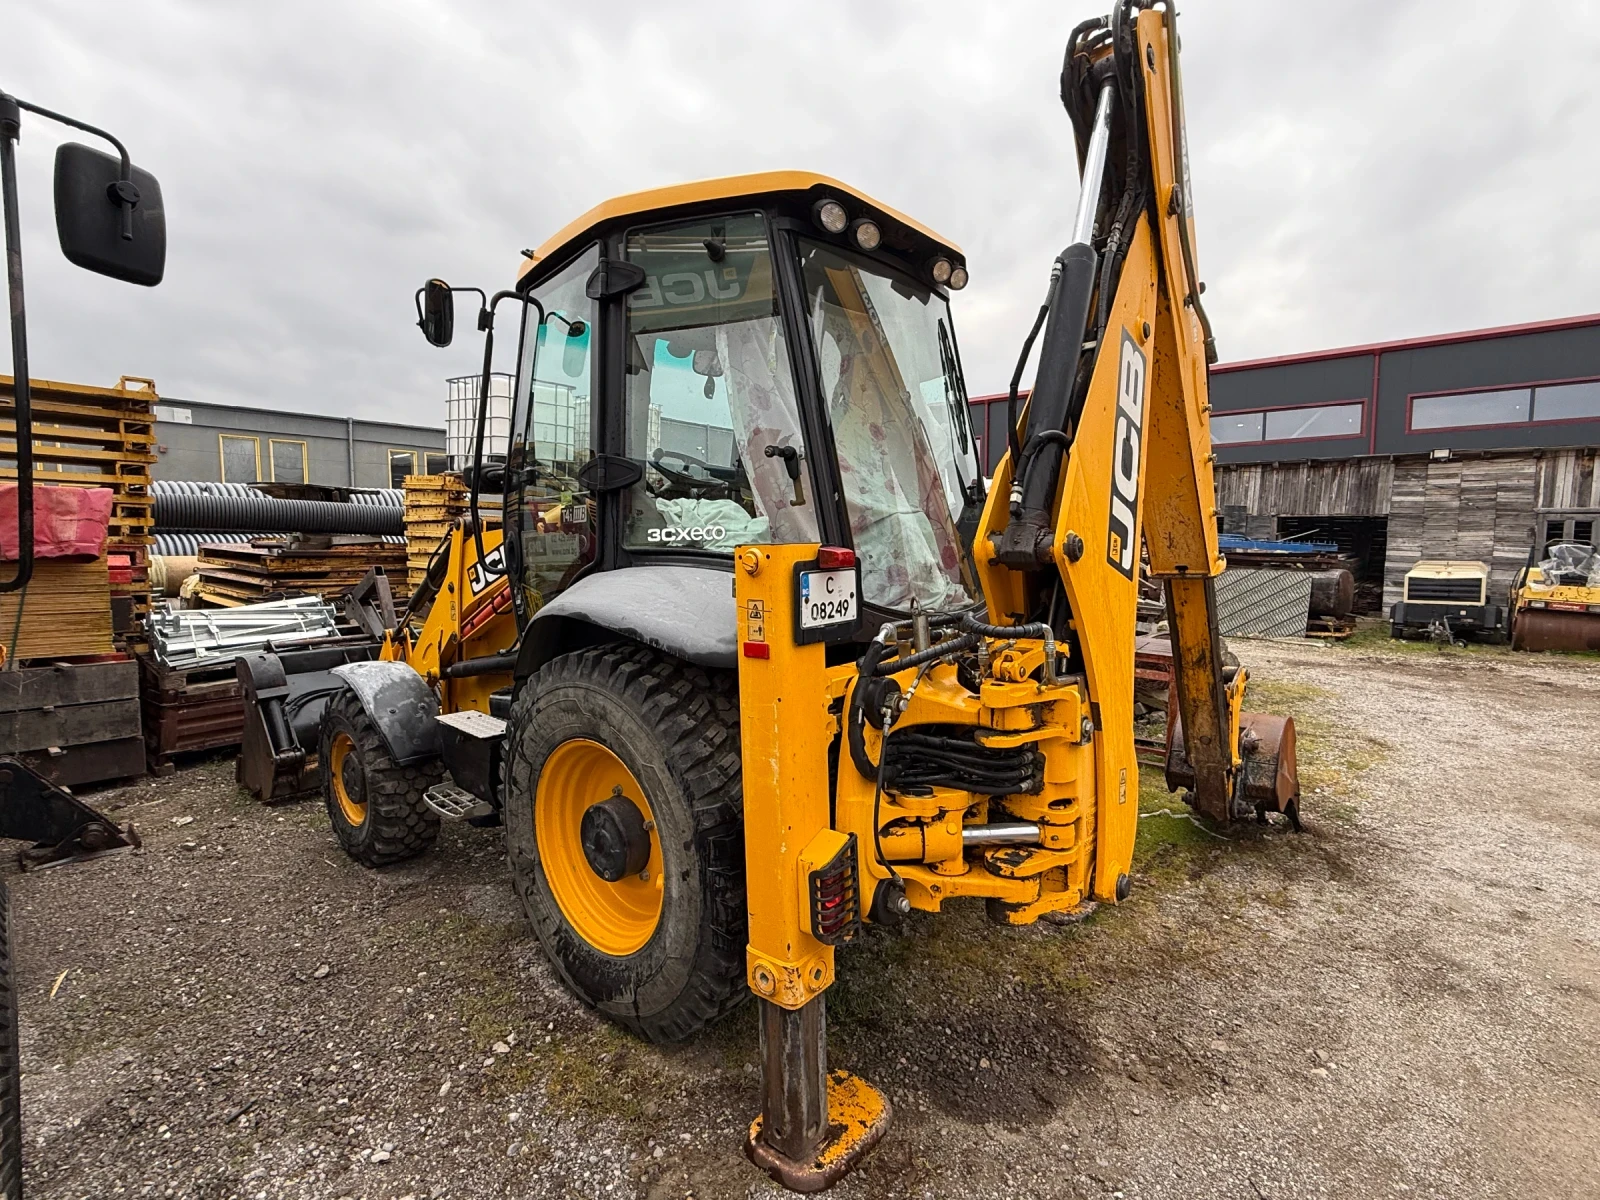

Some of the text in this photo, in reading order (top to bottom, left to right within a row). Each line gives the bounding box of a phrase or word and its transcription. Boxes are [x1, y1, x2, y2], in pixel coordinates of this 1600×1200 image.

[1112, 339, 1144, 570] JCB
[471, 545, 506, 593] JC
[826, 576, 835, 594] C
[811, 599, 849, 621] 08249
